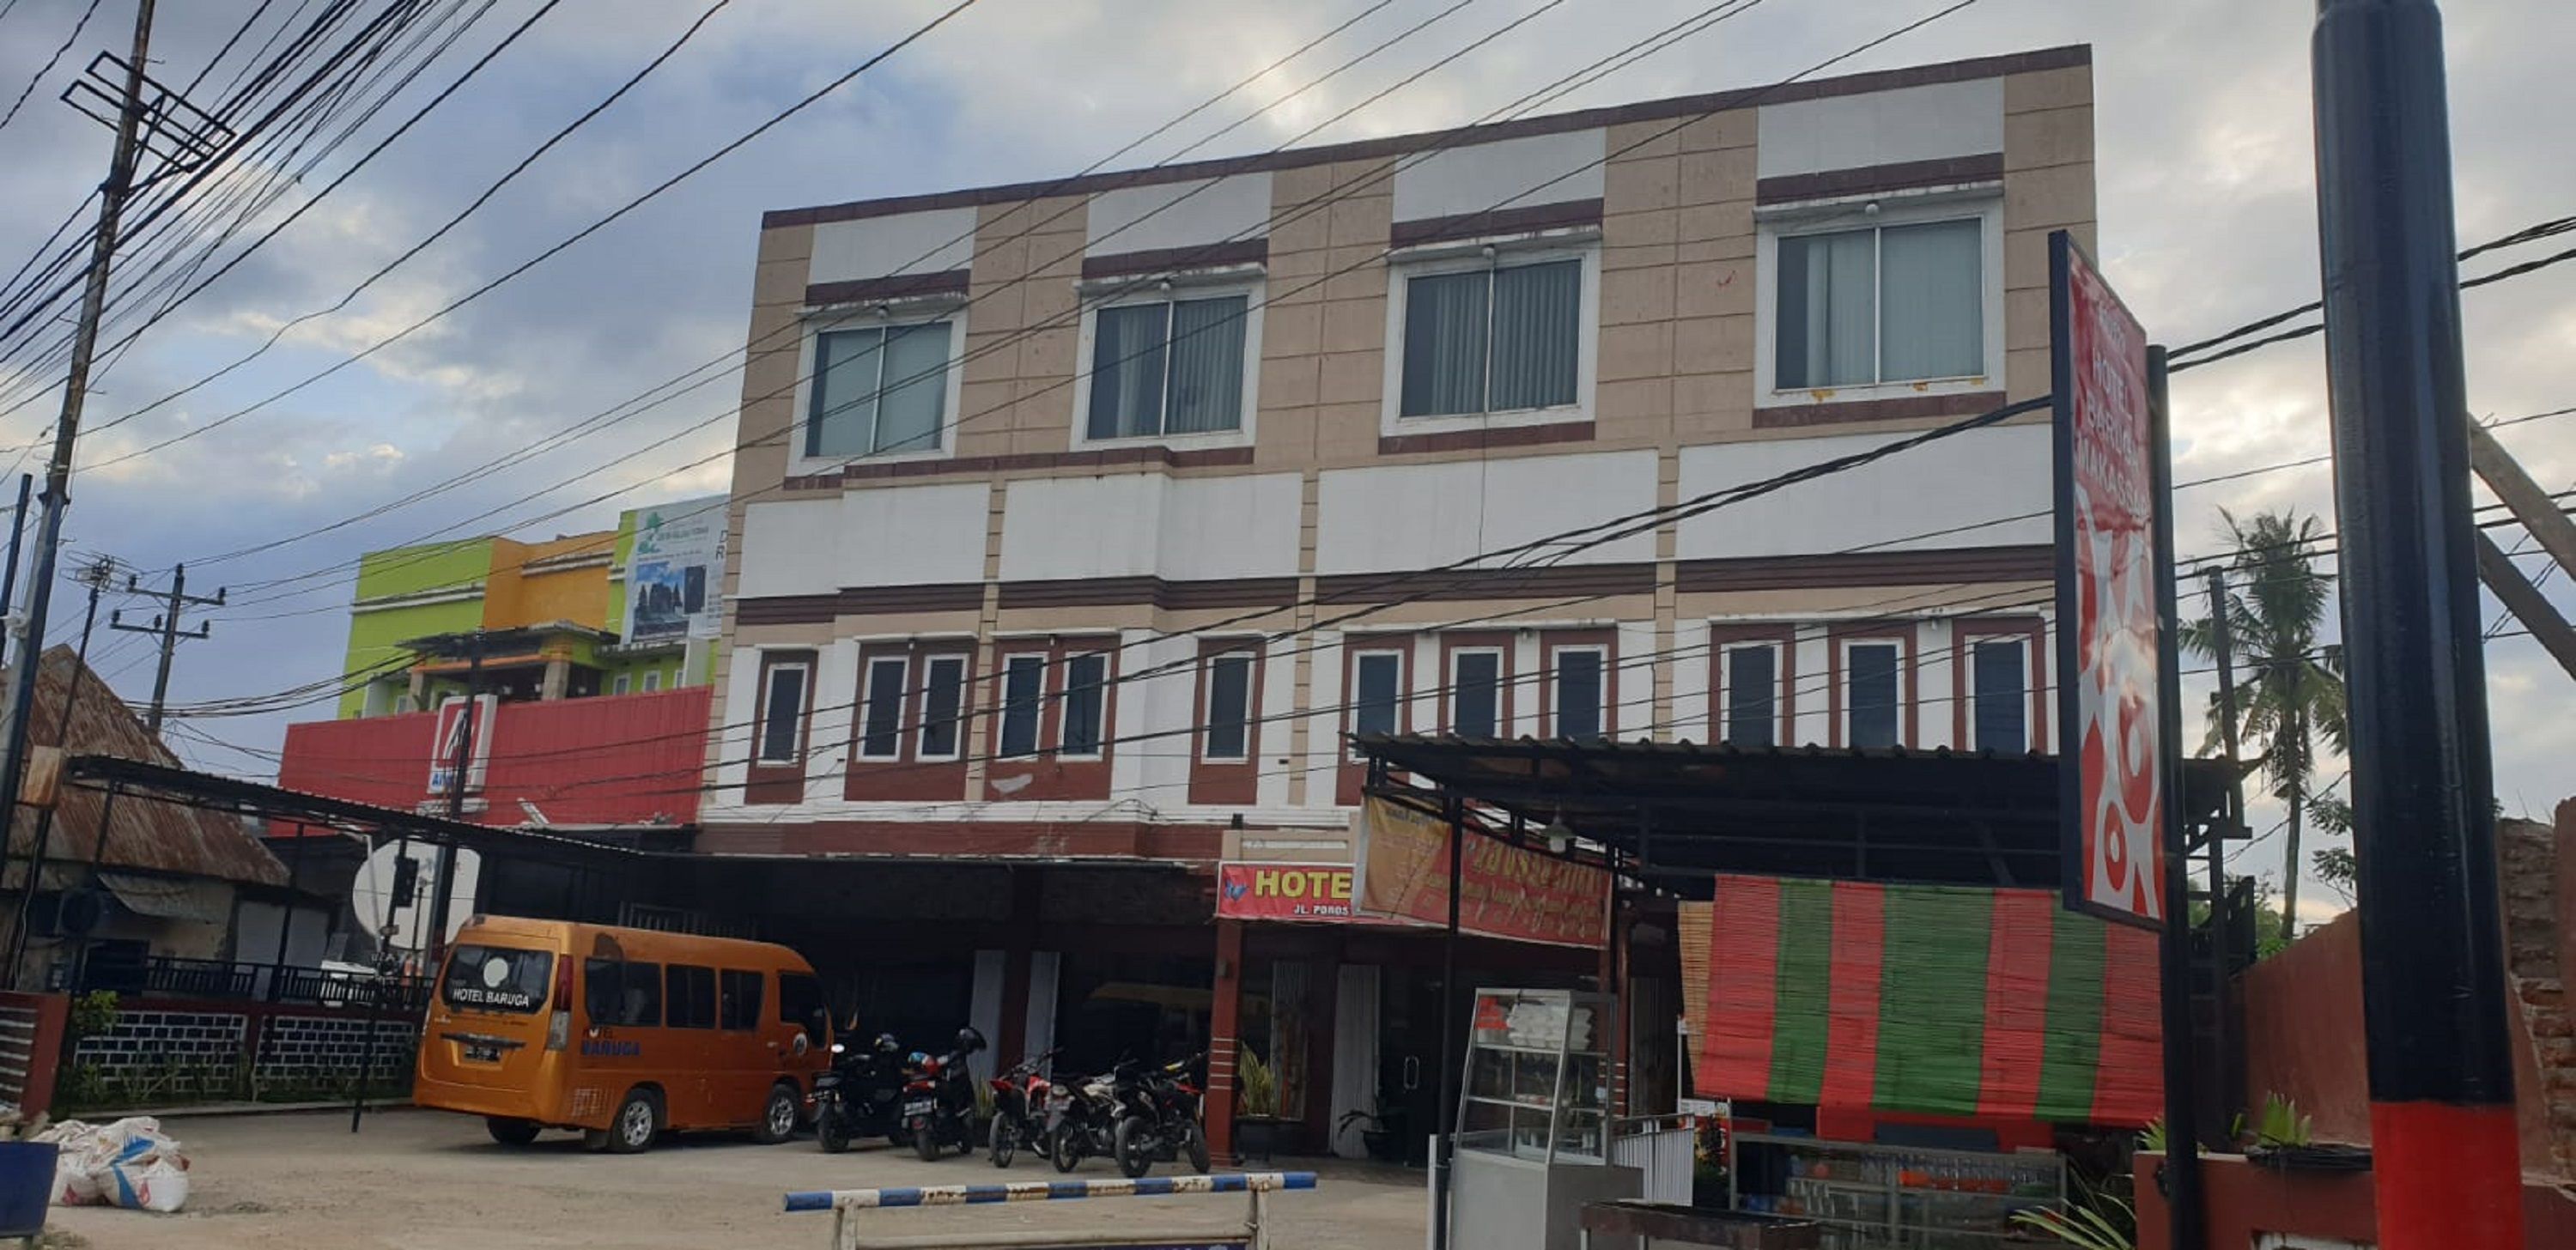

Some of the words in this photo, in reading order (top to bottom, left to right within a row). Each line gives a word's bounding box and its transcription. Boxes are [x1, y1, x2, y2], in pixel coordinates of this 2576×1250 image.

[2092, 346, 2133, 422] HOTEL
[1294, 904, 1309, 914] JL.
[453, 988, 484, 1003] HOTEL
[486, 991, 530, 1007] BARUGA
